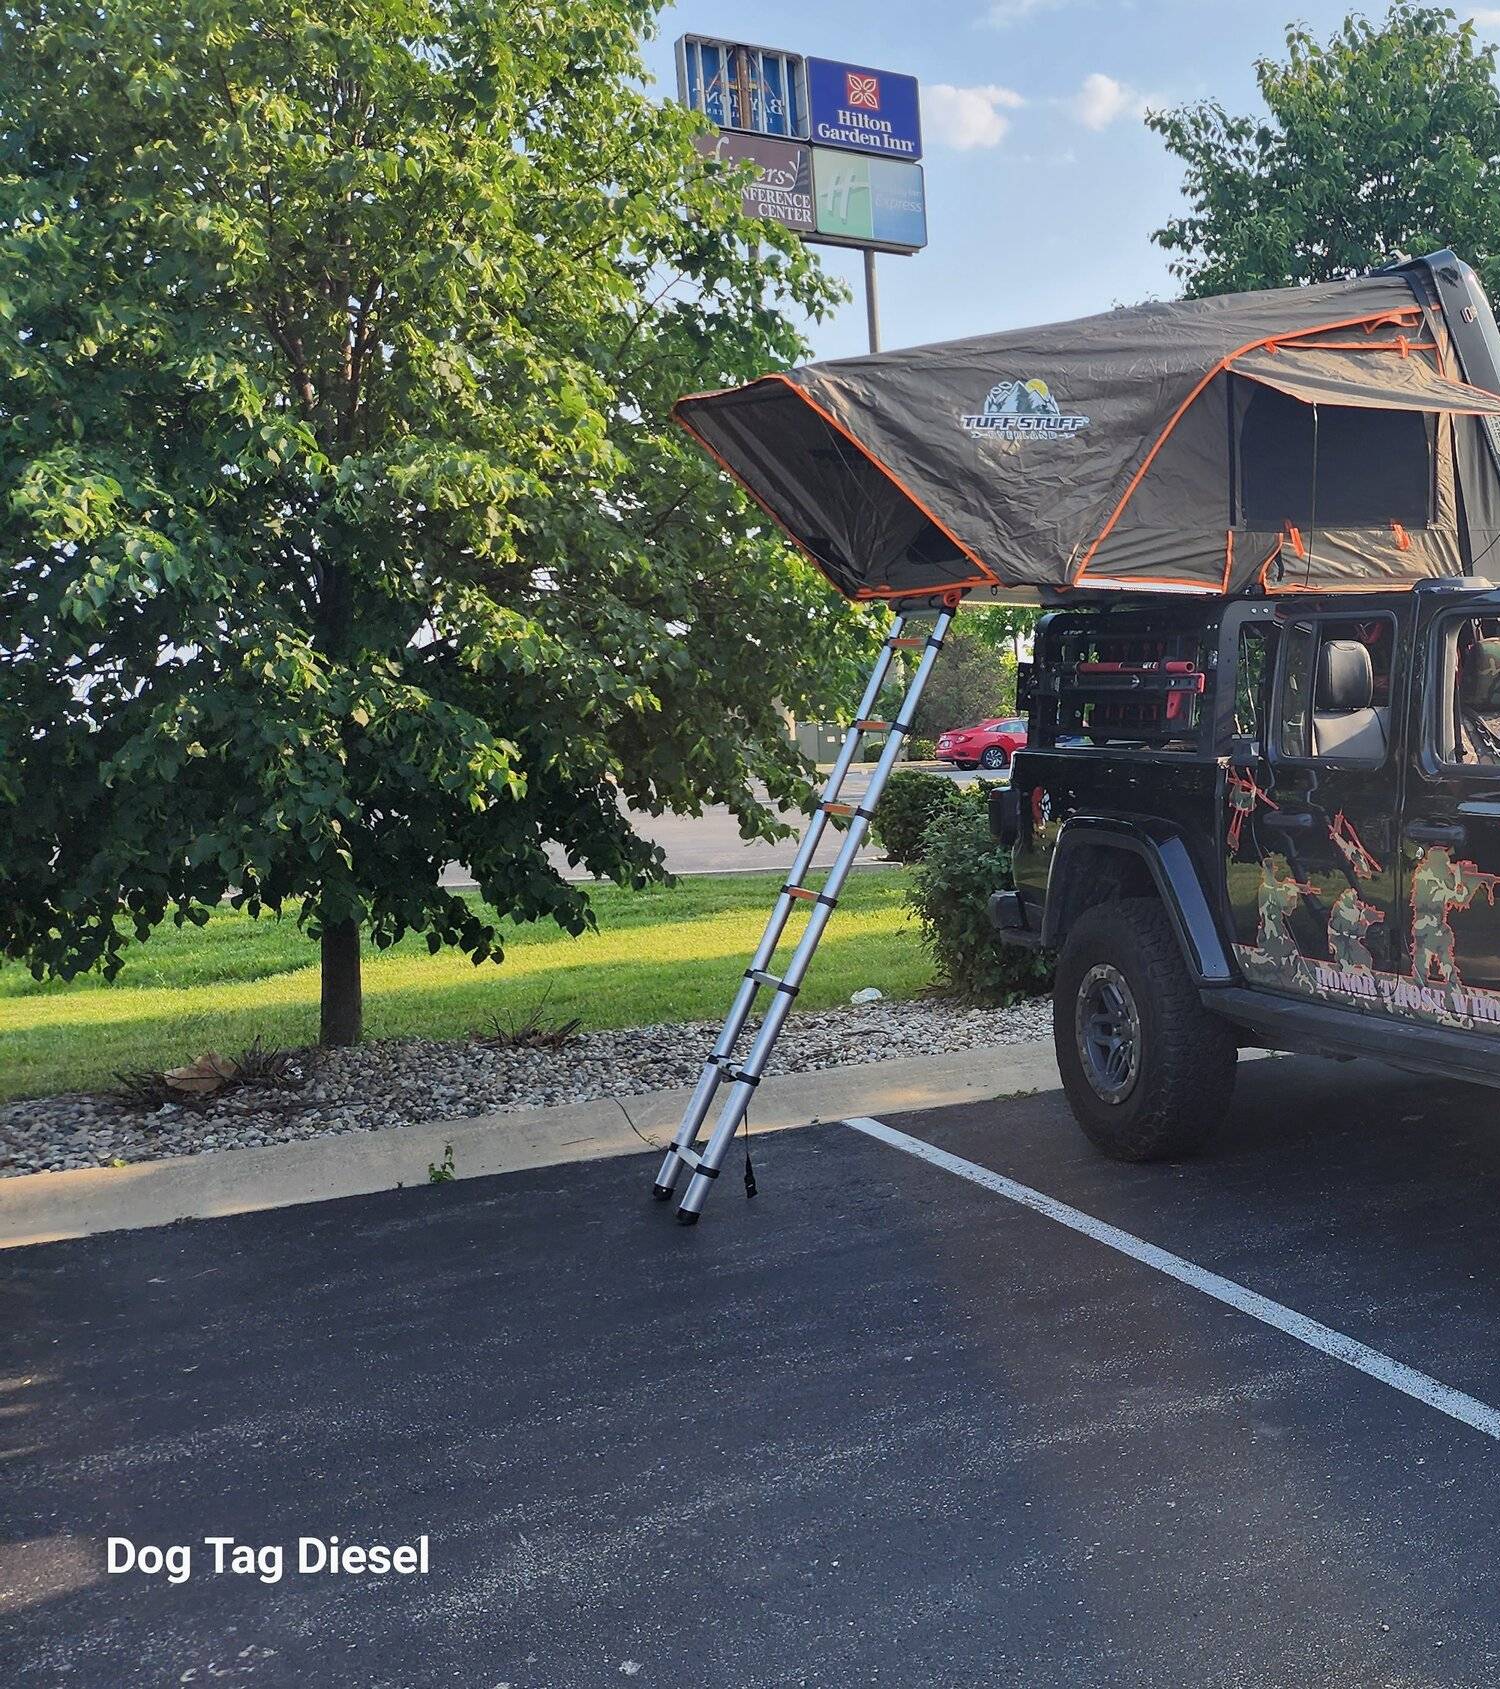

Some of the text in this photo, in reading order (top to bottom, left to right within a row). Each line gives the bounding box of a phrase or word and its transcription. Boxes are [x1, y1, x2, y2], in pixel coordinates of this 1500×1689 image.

[838, 110, 892, 133] Hilton
[818, 123, 914, 152] Garden Inn
[741, 186, 811, 208] NFERENCE
[758, 203, 813, 223] CENTER
[962, 415, 1085, 431] TUFF STUFF
[1315, 966, 1377, 996] HONOR
[1380, 979, 1447, 1013] THOSE
